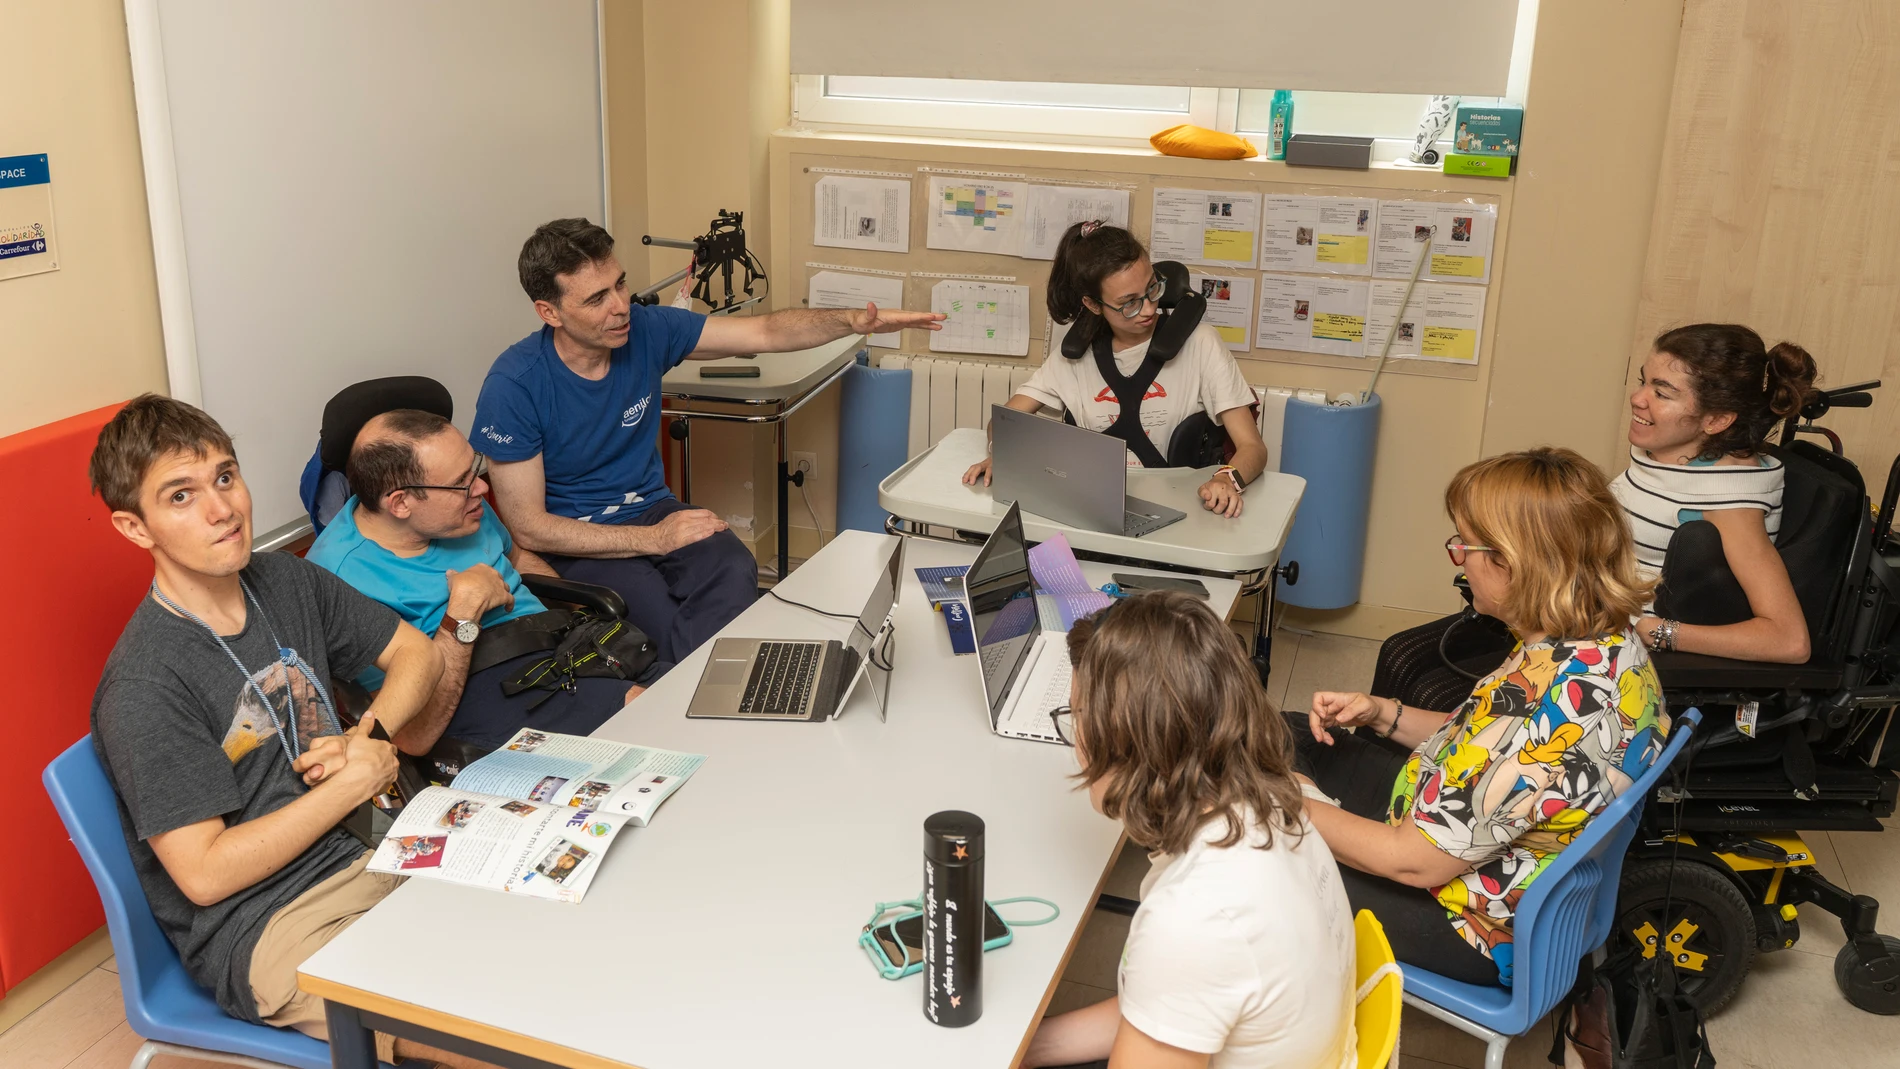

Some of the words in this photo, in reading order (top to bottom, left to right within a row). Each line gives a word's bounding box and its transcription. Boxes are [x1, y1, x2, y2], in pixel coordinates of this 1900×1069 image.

[0, 245, 30, 256] Carrefour
[945, 913, 958, 943] mundo
[946, 956, 955, 965] tu
[942, 967, 956, 996] espejo
